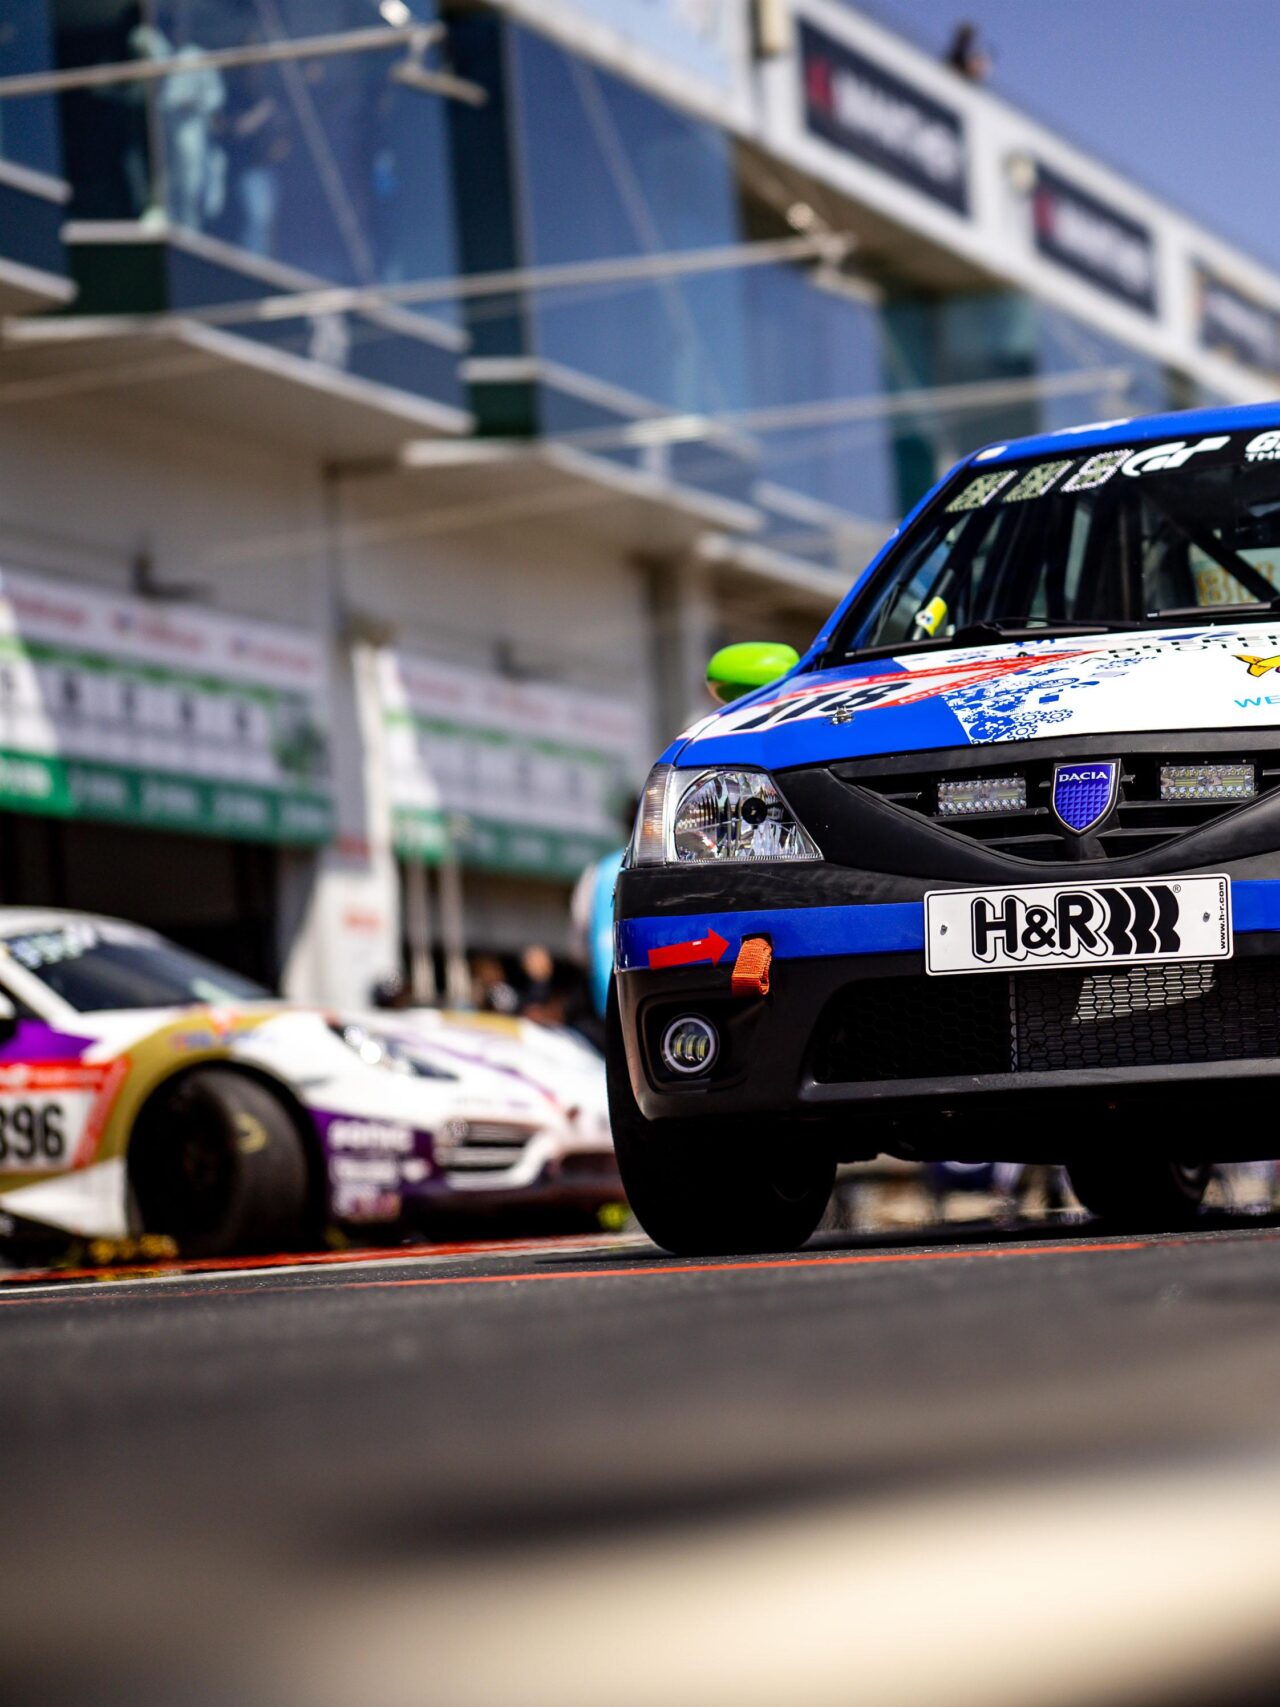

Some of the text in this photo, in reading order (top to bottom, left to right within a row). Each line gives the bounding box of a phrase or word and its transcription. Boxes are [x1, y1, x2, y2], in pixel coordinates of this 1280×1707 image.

[730, 682, 912, 731] 118
[1059, 772, 1108, 782] DACIA
[971, 891, 1108, 962] H&R
[1218, 881, 1226, 950] www.h-r.com
